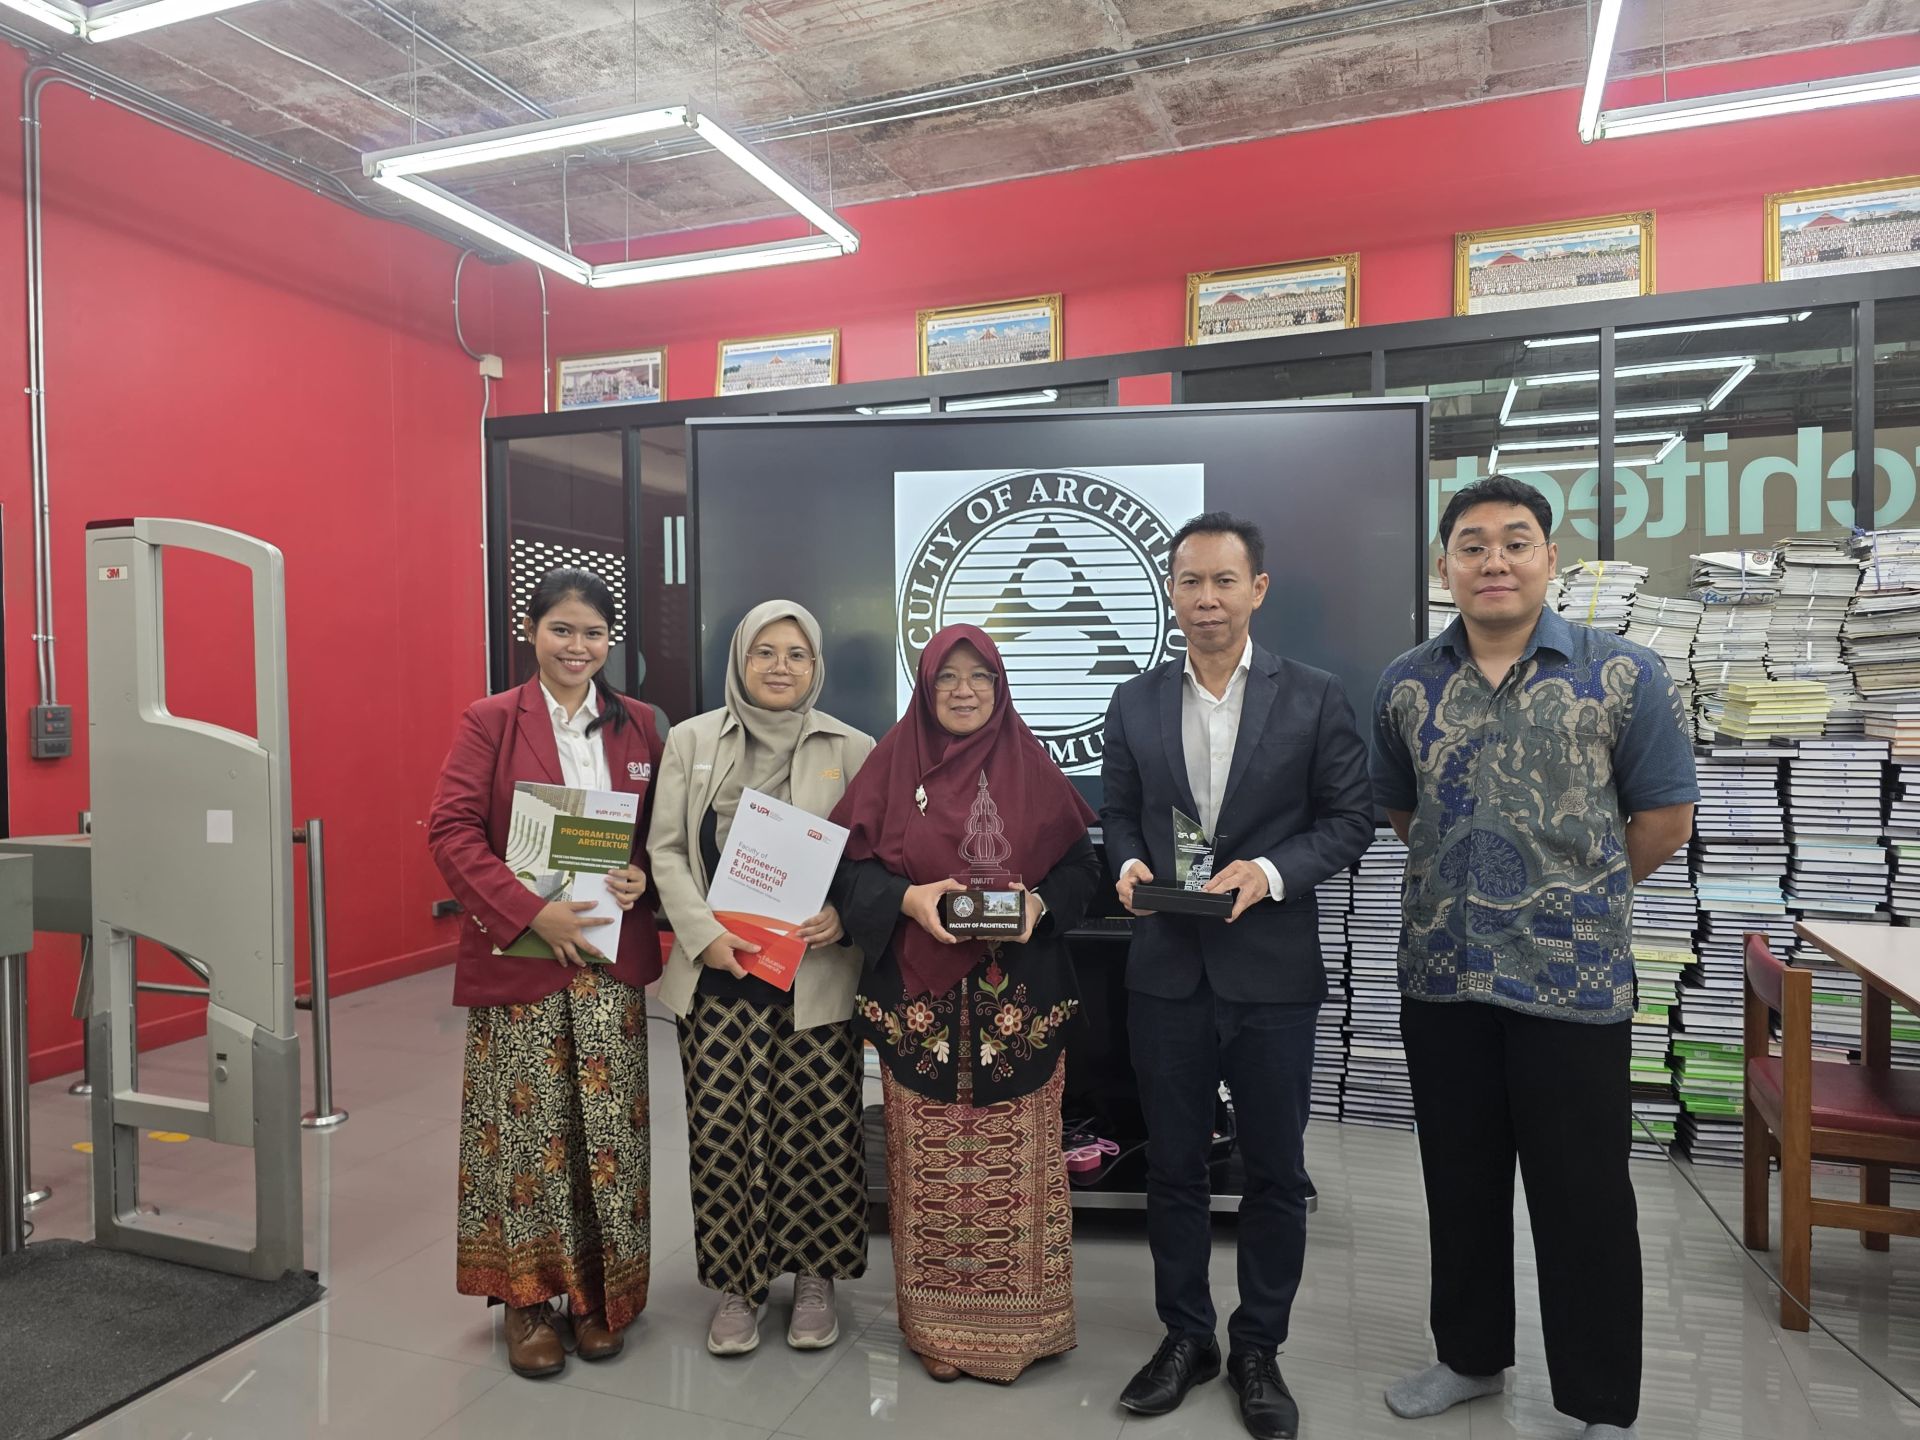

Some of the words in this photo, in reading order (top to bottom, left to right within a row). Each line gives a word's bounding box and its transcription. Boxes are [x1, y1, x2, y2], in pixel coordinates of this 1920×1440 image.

[106, 568, 120, 579] 3M
[907, 526, 962, 651] CULTY
[966, 484, 1014, 524] OF
[1038, 728, 1105, 764] MU
[560, 827, 604, 838] PROGRAM
[605, 832, 629, 842] STUDI
[578, 838, 629, 849] ARSITEKTUR
[739, 841, 760, 856] Faculty
[736, 849, 787, 880] Engineering
[741, 862, 784, 887] Industrial
[730, 867, 773, 892] Education
